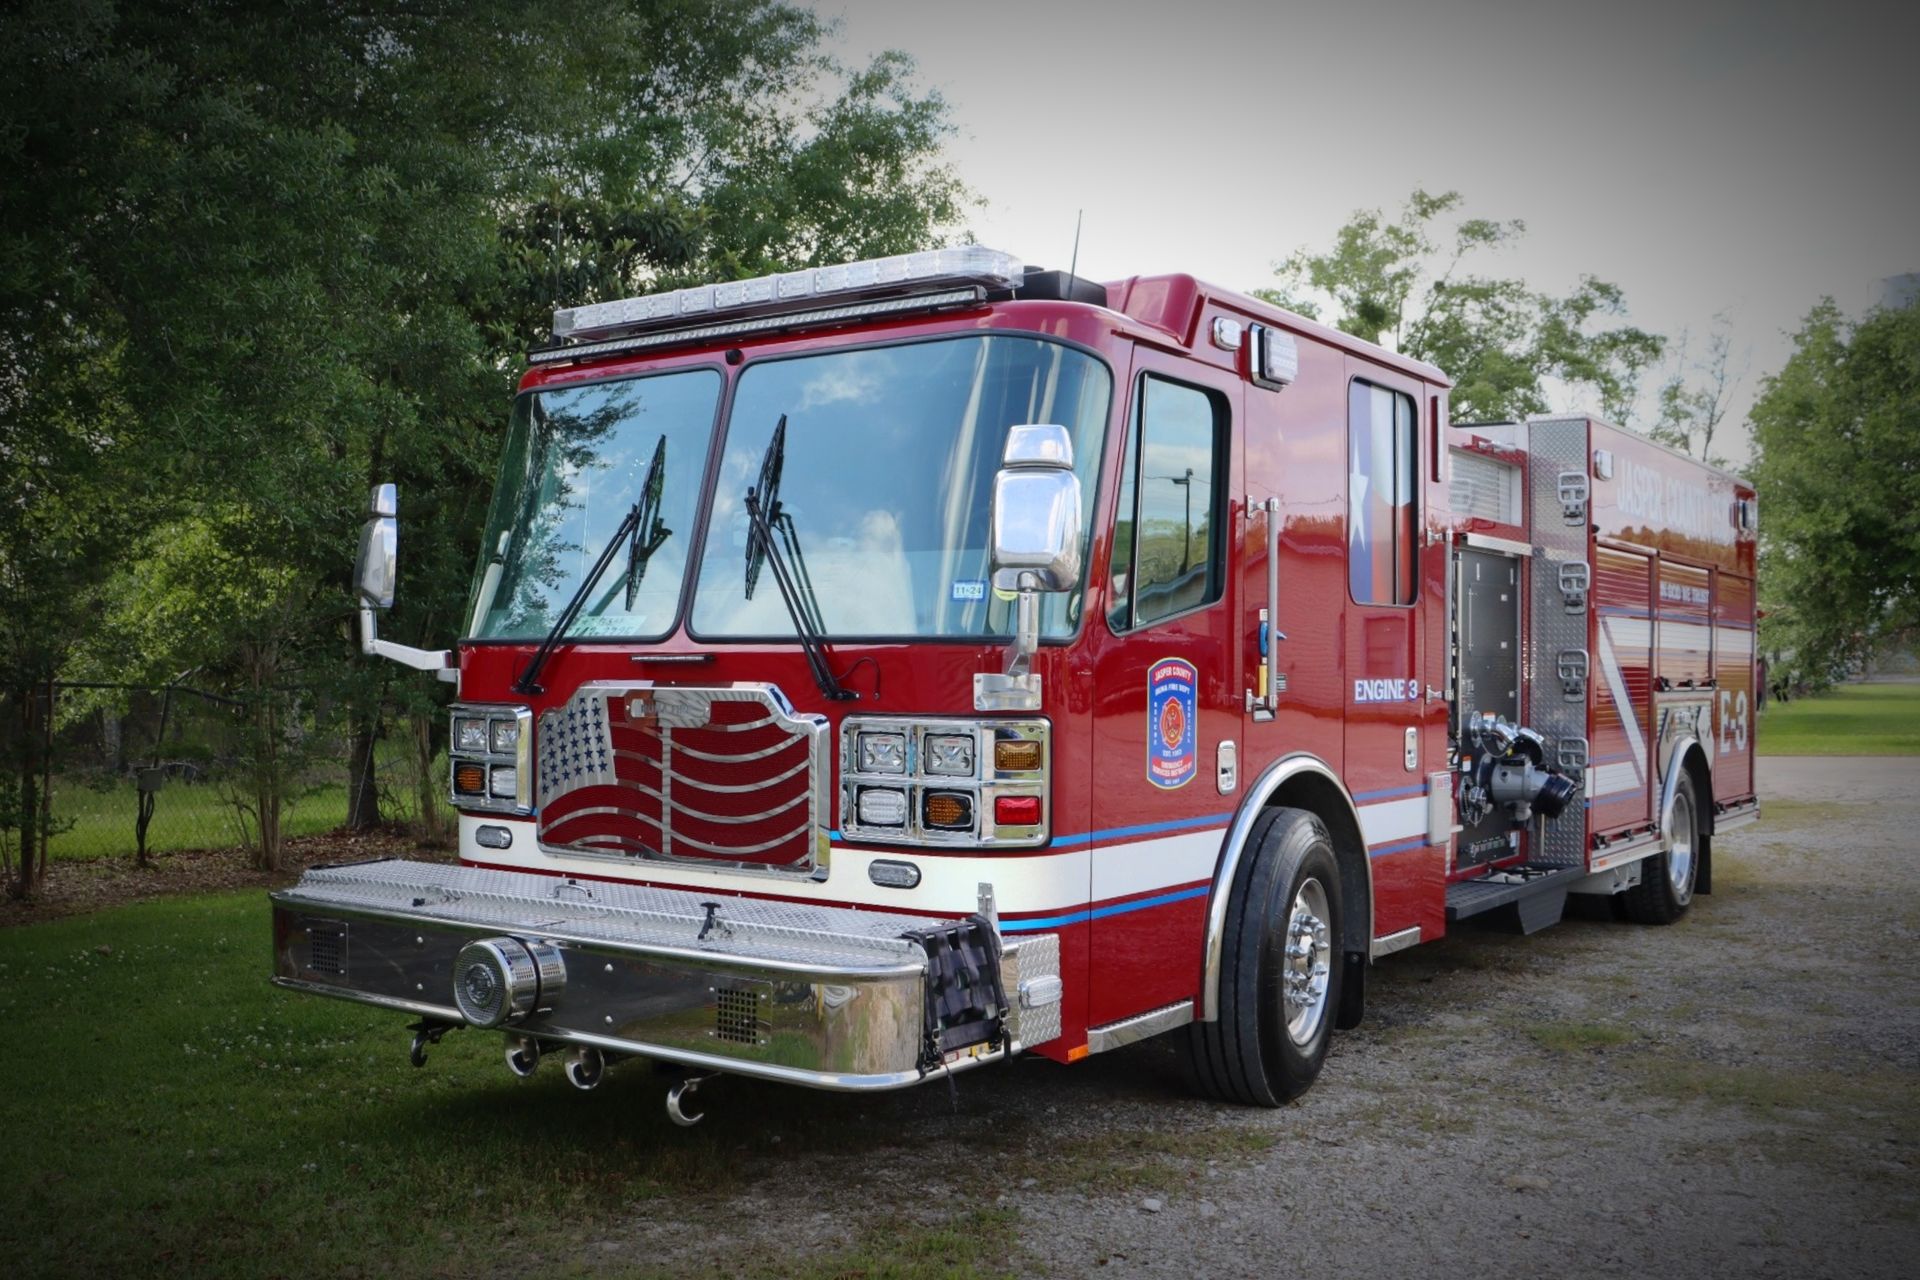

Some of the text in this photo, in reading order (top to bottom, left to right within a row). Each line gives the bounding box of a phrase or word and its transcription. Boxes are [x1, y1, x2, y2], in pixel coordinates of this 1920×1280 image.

[1617, 457, 1662, 523] JASPER
[1354, 679, 1418, 701] ENGINE 3
[1720, 690, 1747, 754] E-3
